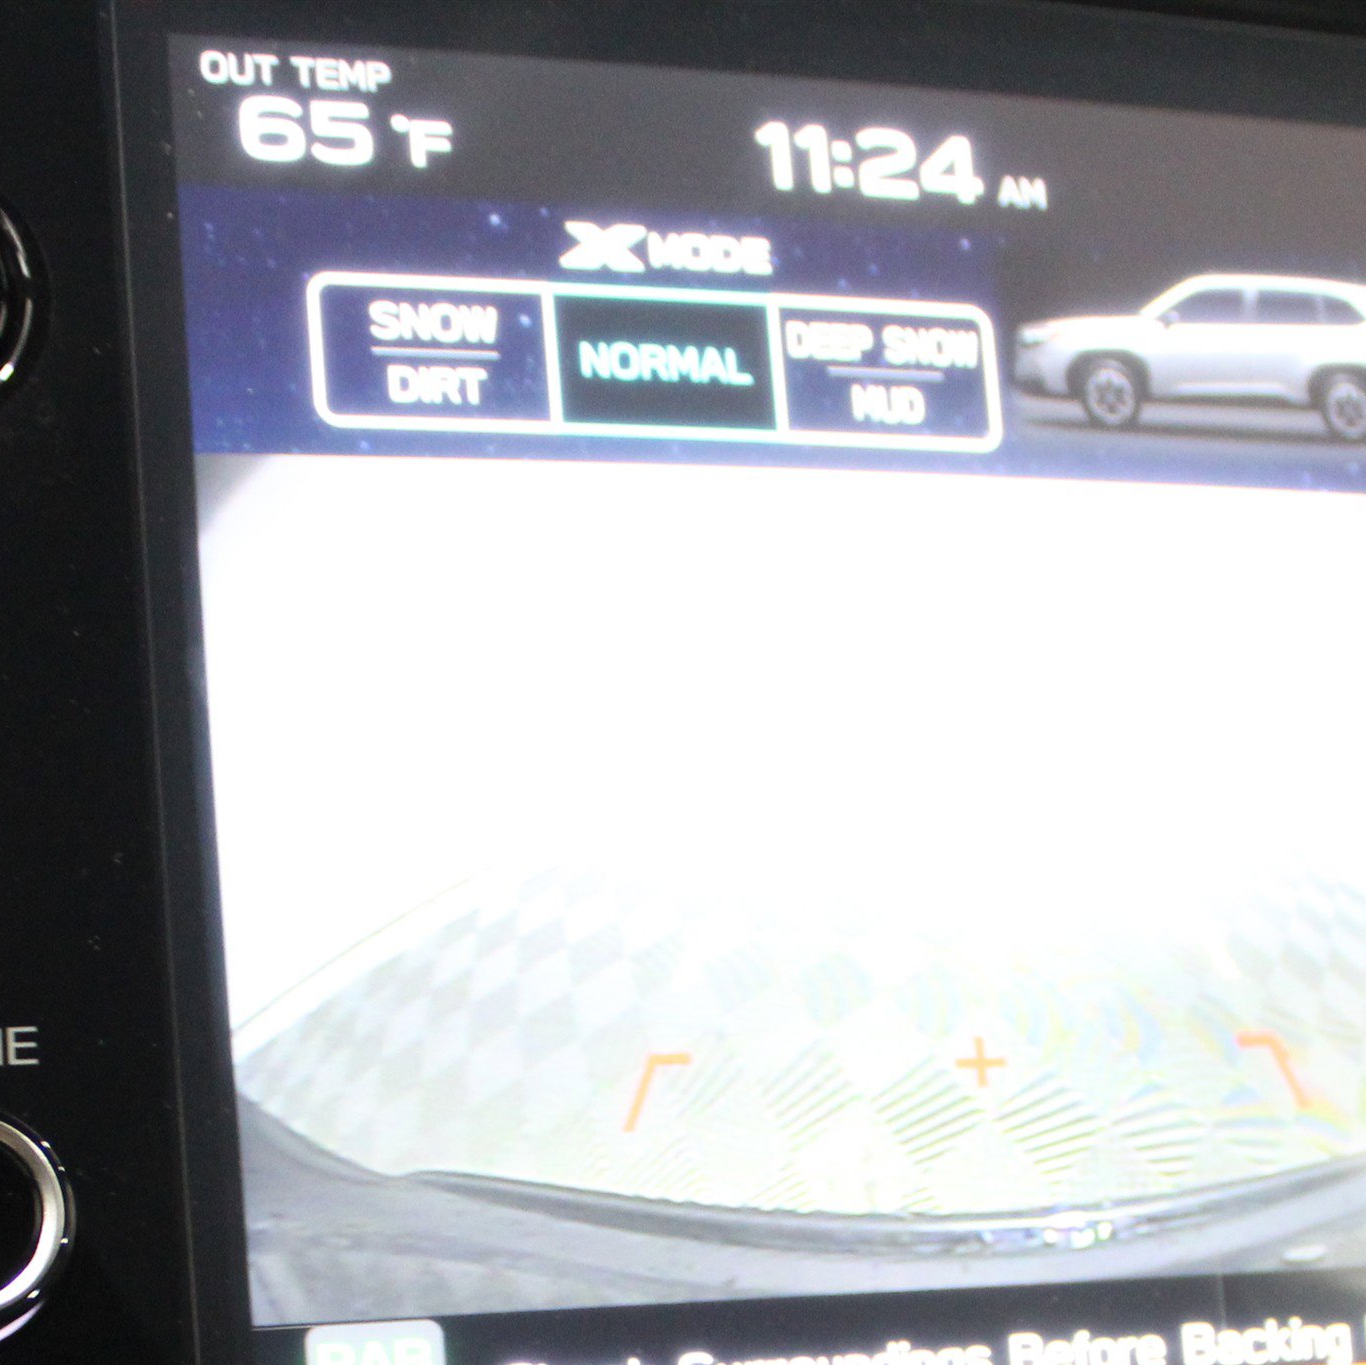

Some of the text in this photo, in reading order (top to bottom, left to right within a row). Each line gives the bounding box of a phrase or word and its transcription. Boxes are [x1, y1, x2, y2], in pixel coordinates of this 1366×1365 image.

[200, 49, 393, 95] OUT TEMP
[236, 95, 376, 168] 65
[755, 120, 1048, 211] 11:24 AM
[368, 300, 498, 345] SNOW
[786, 320, 978, 370] DEEP SNOW
[387, 363, 487, 406] DIRT
[580, 341, 755, 388] NORMAL
[851, 384, 926, 426] MUD
